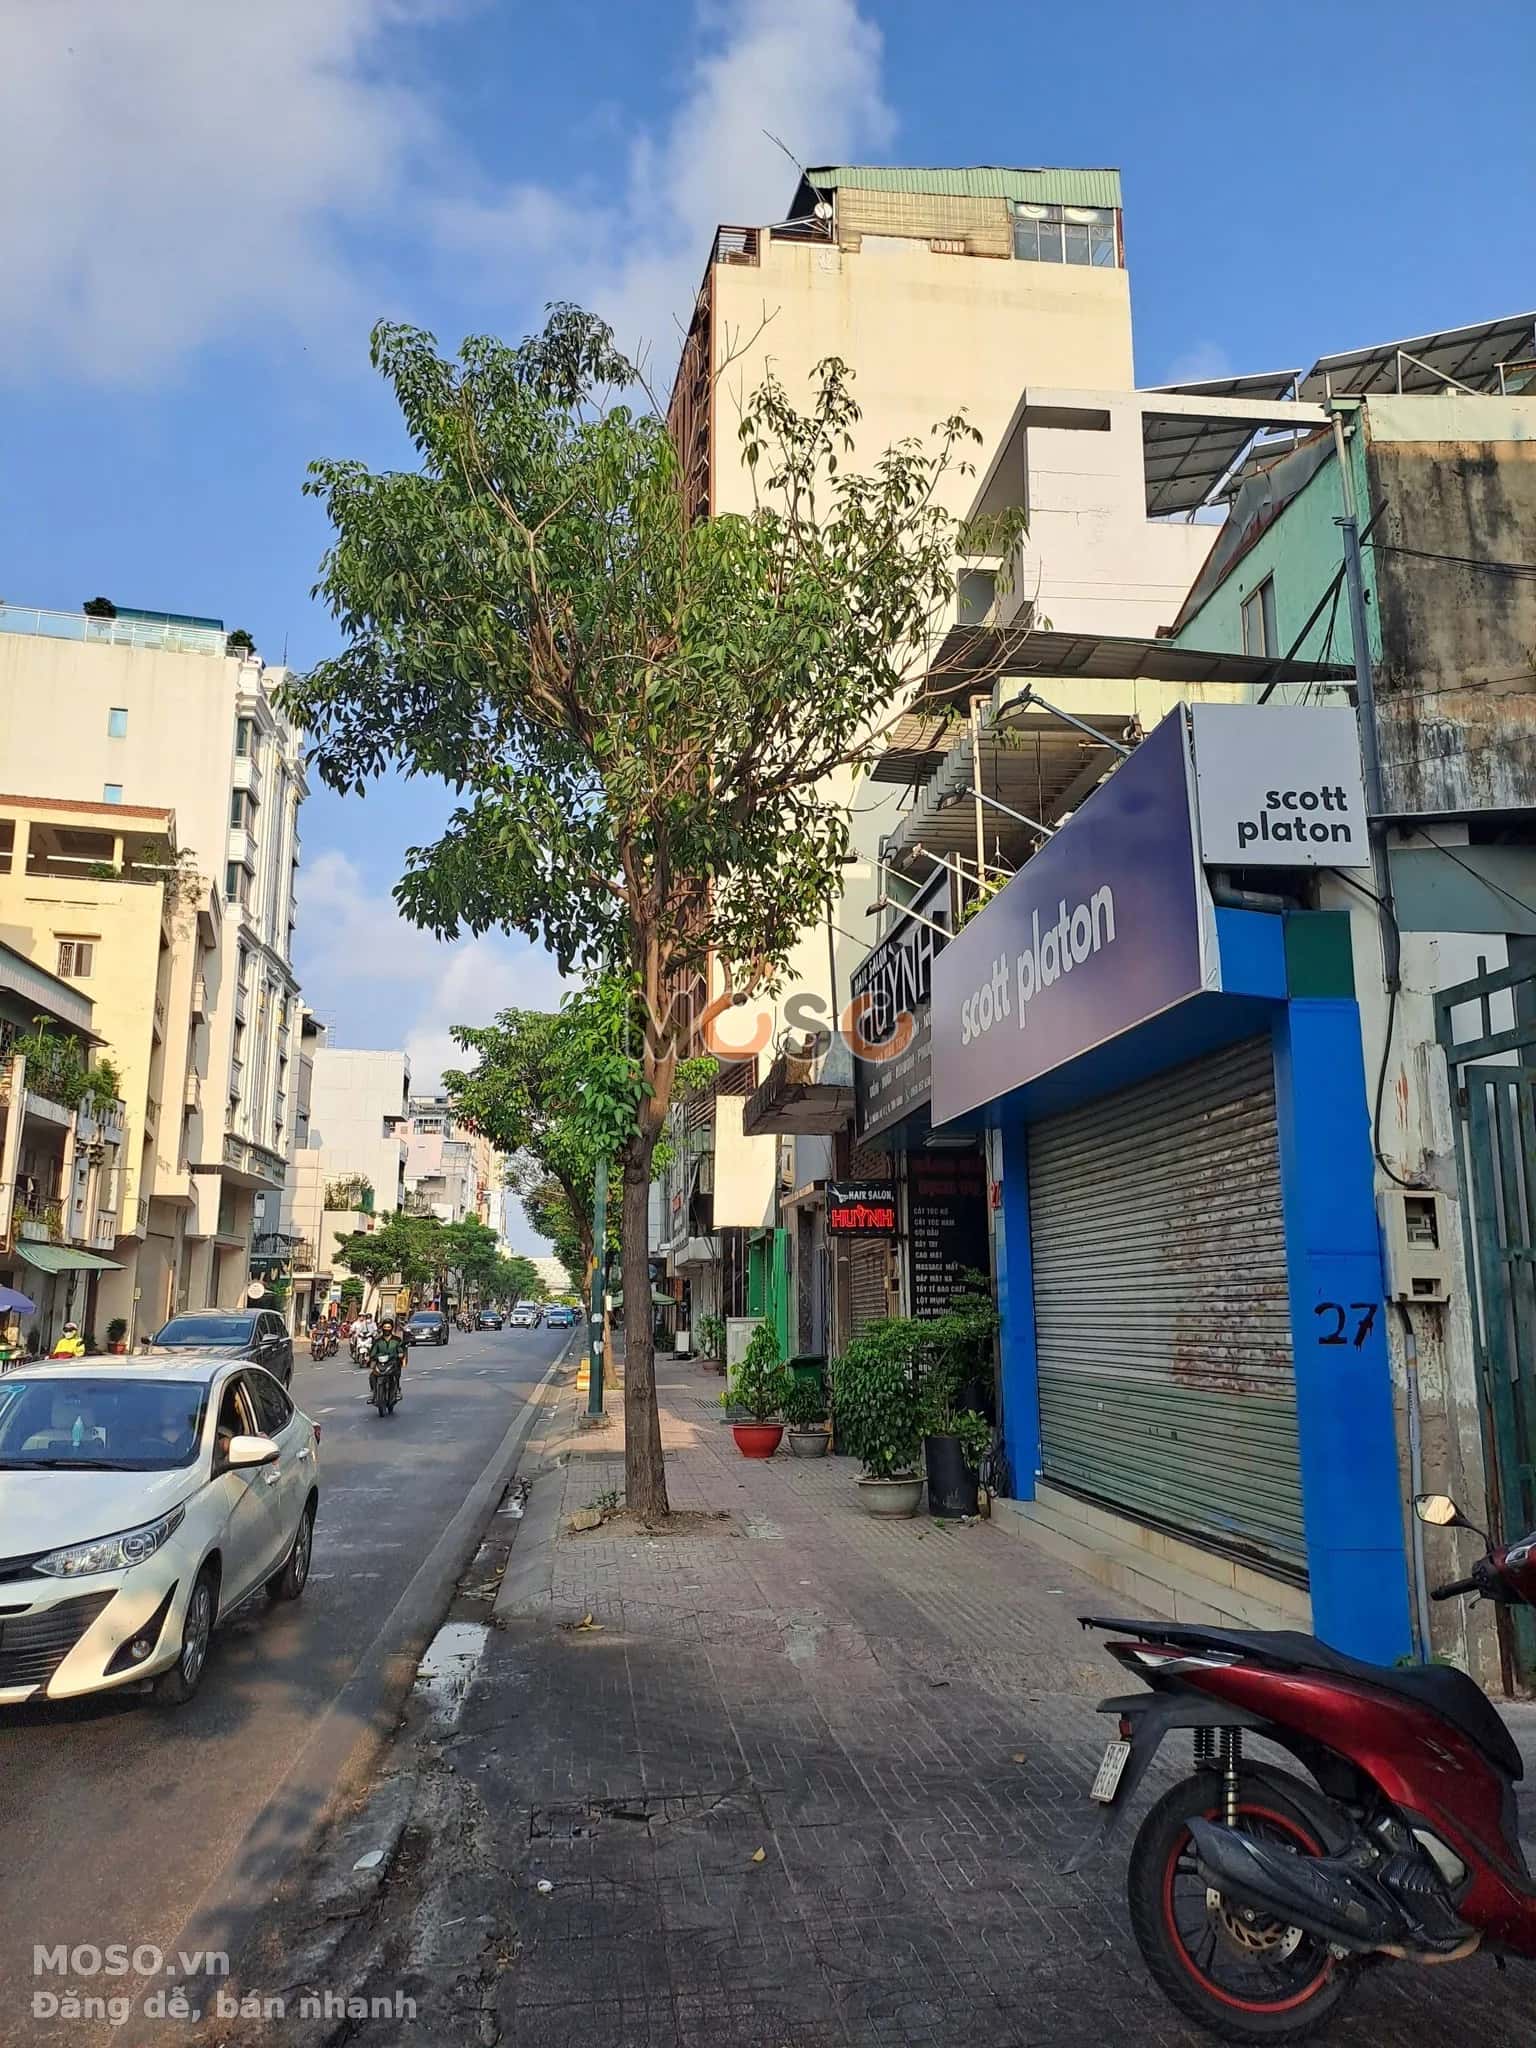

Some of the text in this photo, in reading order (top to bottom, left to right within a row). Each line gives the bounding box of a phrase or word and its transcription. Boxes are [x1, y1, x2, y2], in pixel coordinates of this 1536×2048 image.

[1265, 785, 1349, 811] scott
[1237, 810, 1352, 849] platon
[960, 951, 1011, 1046] scott
[1016, 884, 1117, 1030] platon
[848, 1190, 892, 1201] HAIR SALON
[1314, 1301, 1378, 1351] 27
